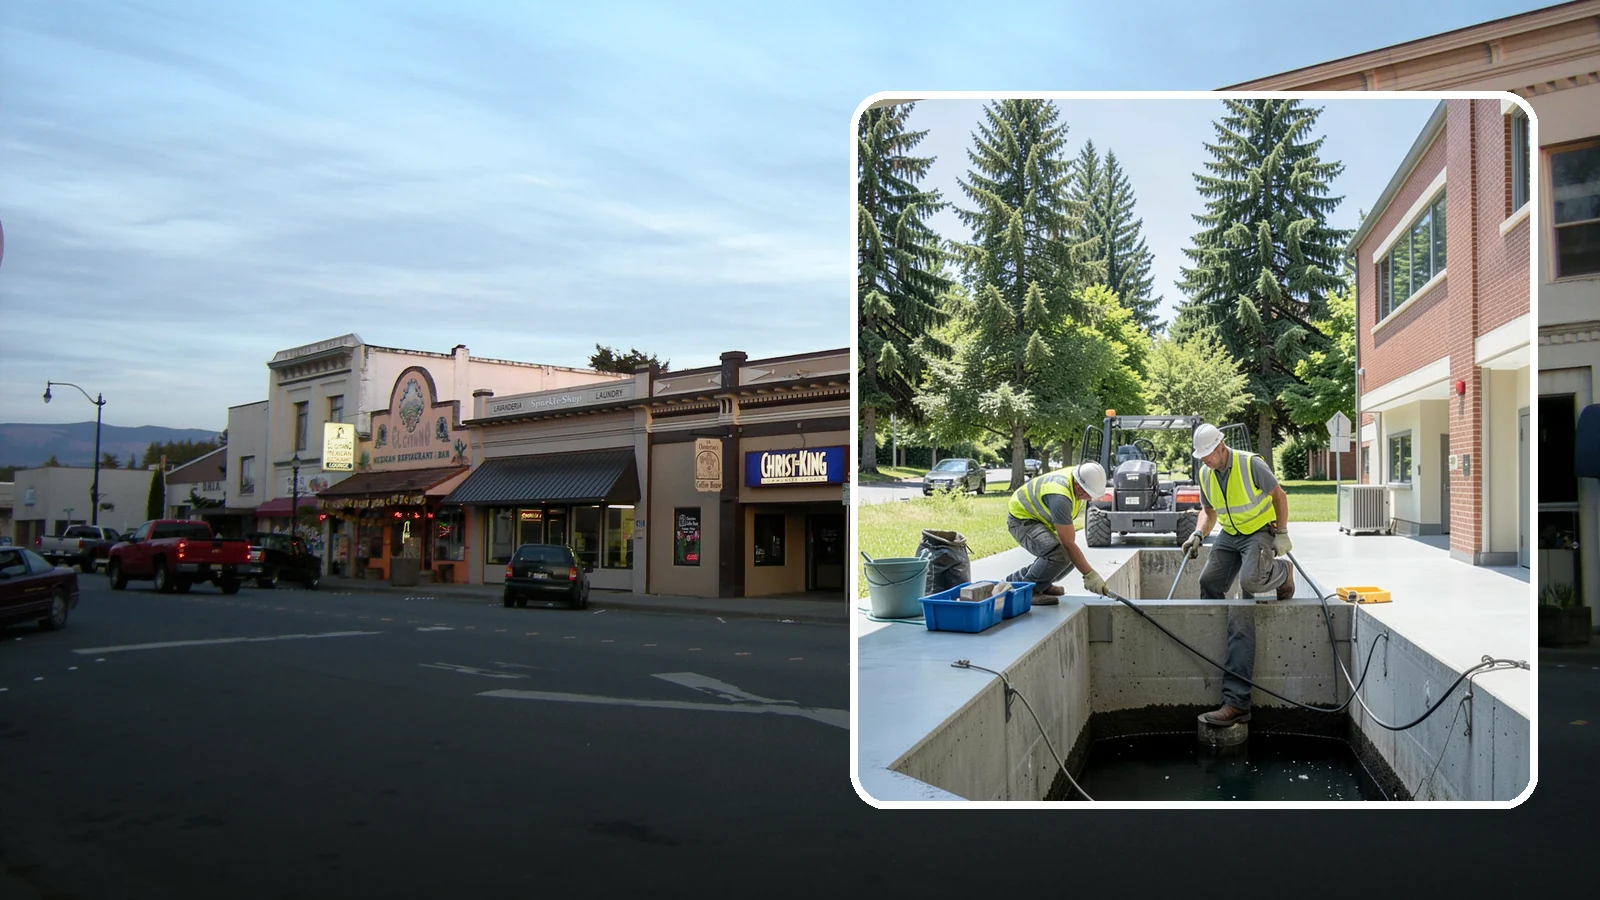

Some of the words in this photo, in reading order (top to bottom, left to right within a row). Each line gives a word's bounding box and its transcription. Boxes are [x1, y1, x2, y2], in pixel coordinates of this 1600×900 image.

[493, 402, 523, 413] LAVANDERIA
[530, 397, 561, 410] Sparkle
[561, 394, 583, 407] Shop
[595, 389, 624, 400] LAUNDRY
[373, 454, 396, 464] MEXICAN
[397, 451, 433, 463] RESTAURANT
[437, 450, 450, 459] BAR
